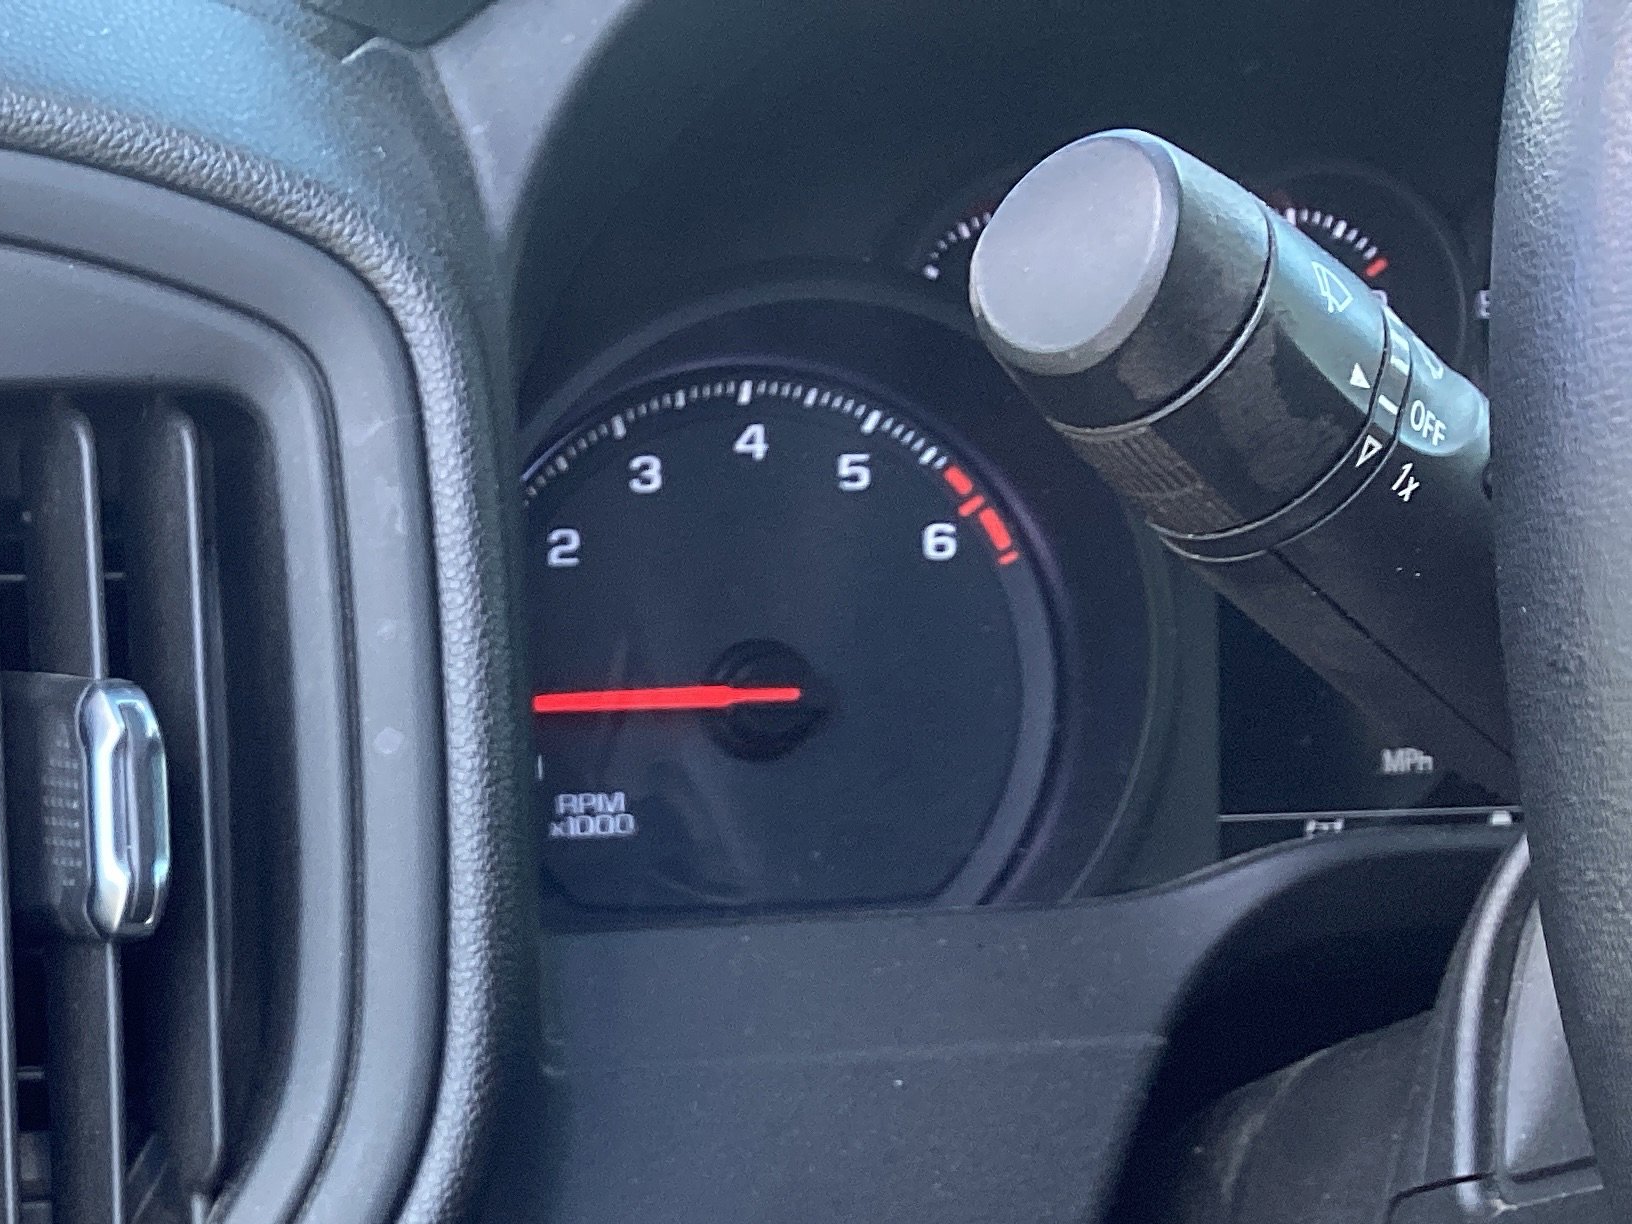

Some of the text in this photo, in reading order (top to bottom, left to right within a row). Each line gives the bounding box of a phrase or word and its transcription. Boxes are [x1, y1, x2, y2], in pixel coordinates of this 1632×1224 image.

[1410, 399, 1447, 447] OFF
[734, 425, 768, 461] 4
[629, 456, 662, 493] 3
[837, 454, 870, 491] 5
[1391, 462, 1420, 502] 1x
[547, 530, 580, 566] 2
[922, 523, 957, 560] 6
[555, 791, 626, 815] RPM
